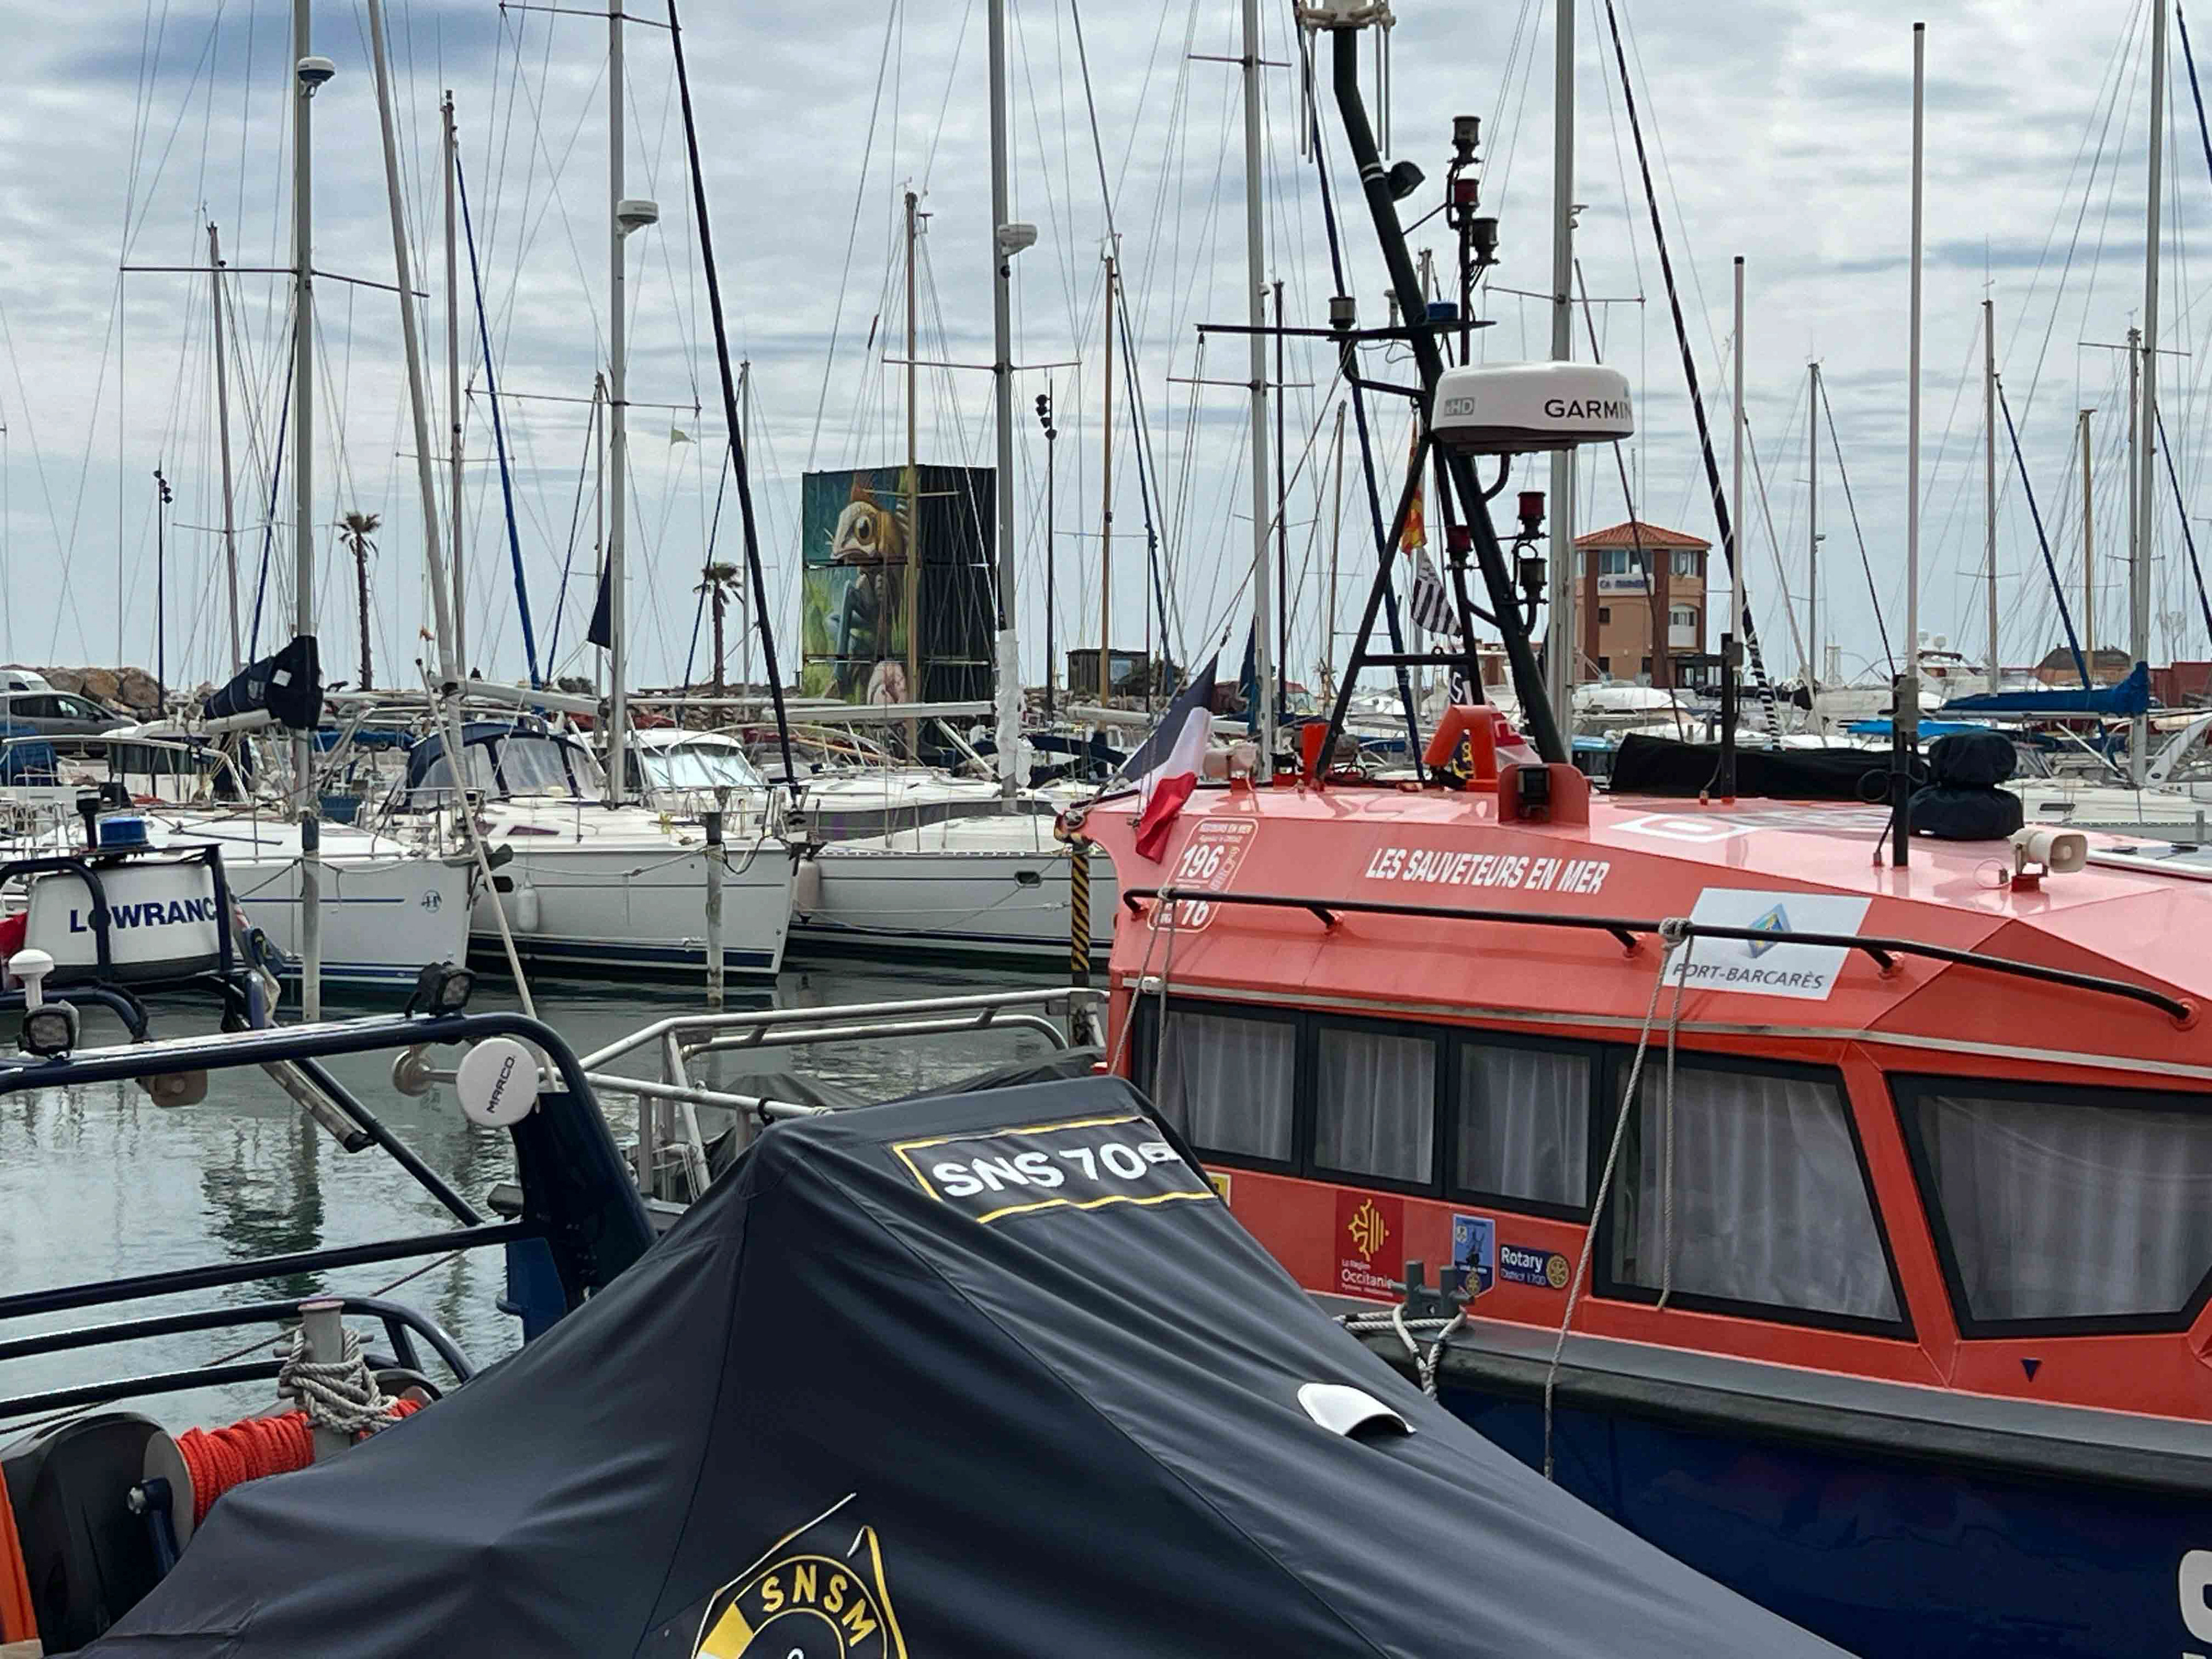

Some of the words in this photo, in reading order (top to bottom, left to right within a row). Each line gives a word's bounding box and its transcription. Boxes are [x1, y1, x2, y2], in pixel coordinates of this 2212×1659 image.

[1178, 844, 1225, 878] 196
[1365, 848, 1406, 879] LES
[1402, 850, 1529, 888] SAUVETEURS
[1524, 858, 1563, 891] EN
[1556, 860, 1611, 894] MER
[70, 896, 218, 933] LWRANC
[486, 1056, 514, 1113] MARCO
[932, 1152, 1065, 1197] SNS
[1501, 1247, 1543, 1272] Rotary
[762, 1564, 877, 1647] SNSM
